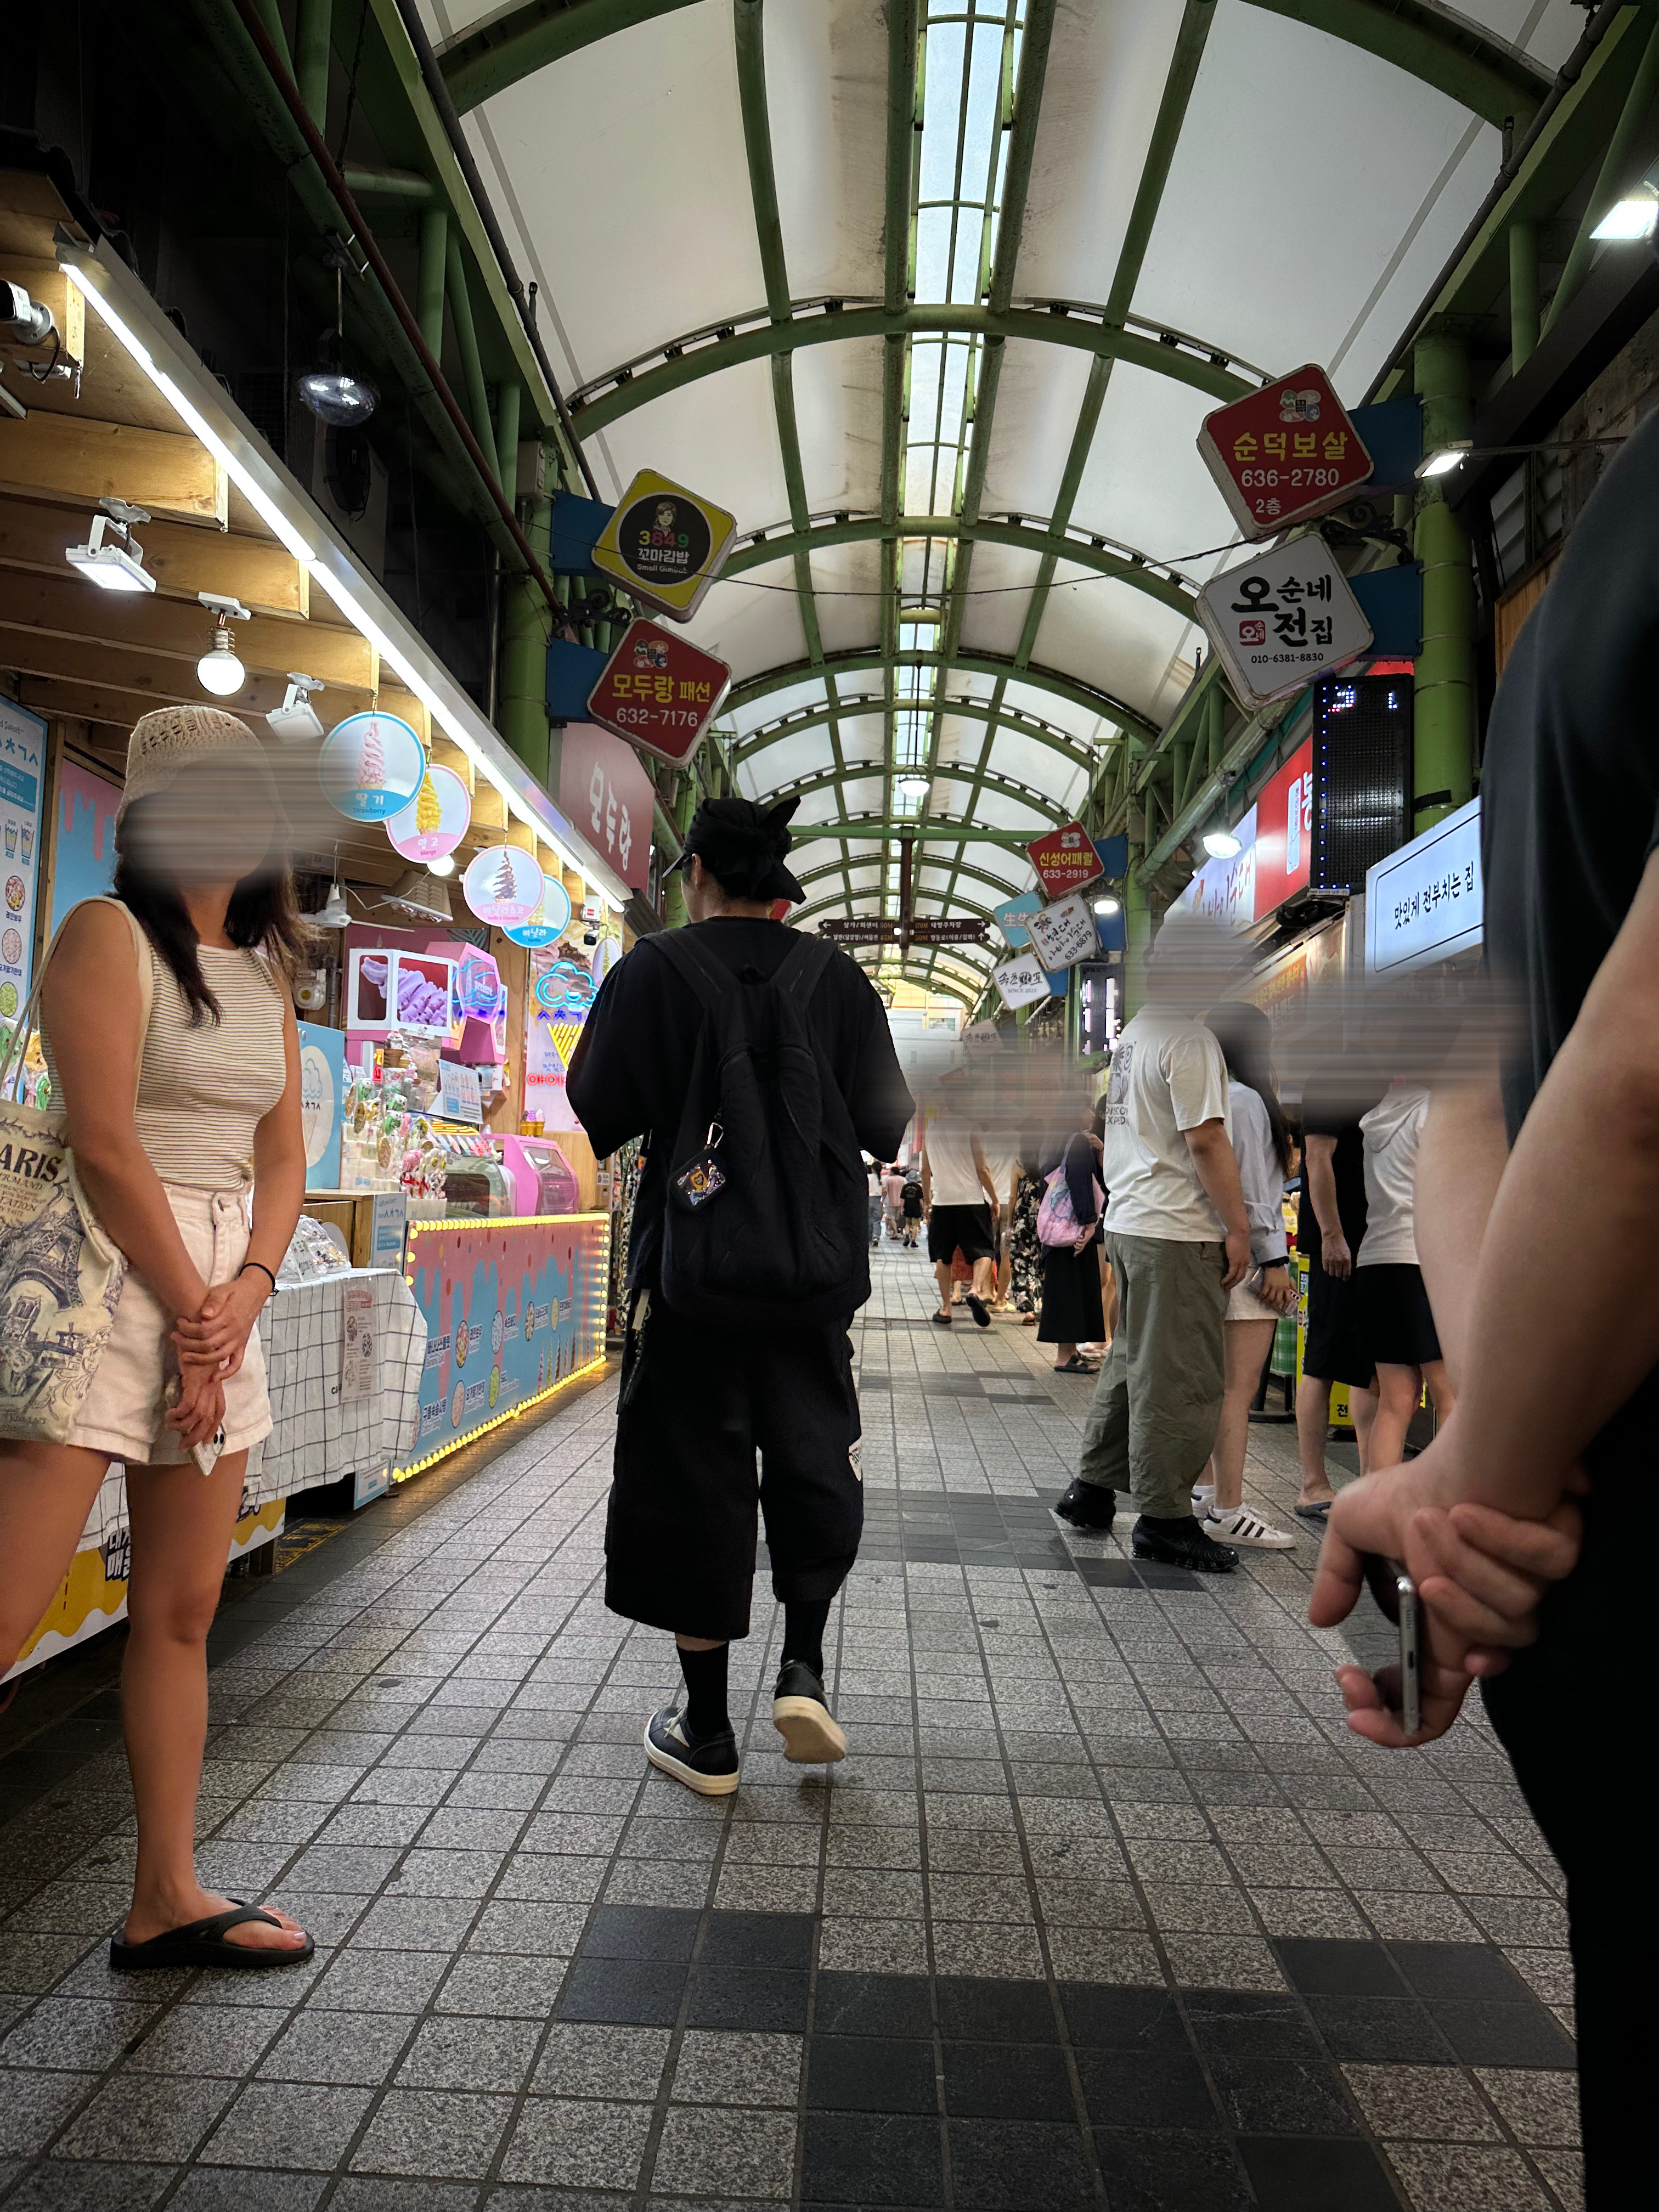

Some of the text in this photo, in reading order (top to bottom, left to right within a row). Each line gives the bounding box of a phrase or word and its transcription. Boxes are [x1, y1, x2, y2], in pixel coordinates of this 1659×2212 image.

[1233, 431, 1348, 461] 순덕보살
[1241, 468, 1339, 487] 636-2780
[1256, 498, 1282, 515] 2층
[639, 530, 689, 548] 3849
[637, 548, 690, 565] 꼬마김밥
[1231, 574, 1332, 613] 오순네
[1272, 606, 1333, 647] 전집
[1250, 653, 1324, 664] 010-6381-8830
[612, 673, 674, 704] 모두랑
[617, 708, 698, 727] 632-7176
[356, 793, 384, 807] 딸기
[589, 761, 632, 872] 모두랑
[417, 837, 438, 850] 망고
[1039, 851, 1093, 867] 신성어패럴
[1043, 869, 1089, 879] 633-2919
[1393, 861, 1475, 930] 맛있게 전부치는 집
[522, 928, 547, 938] 바닐라
[1064, 930, 1093, 961] 633-6879
[527, 1073, 567, 1087] 아이
[1336, 1404, 1348, 1418] 전
